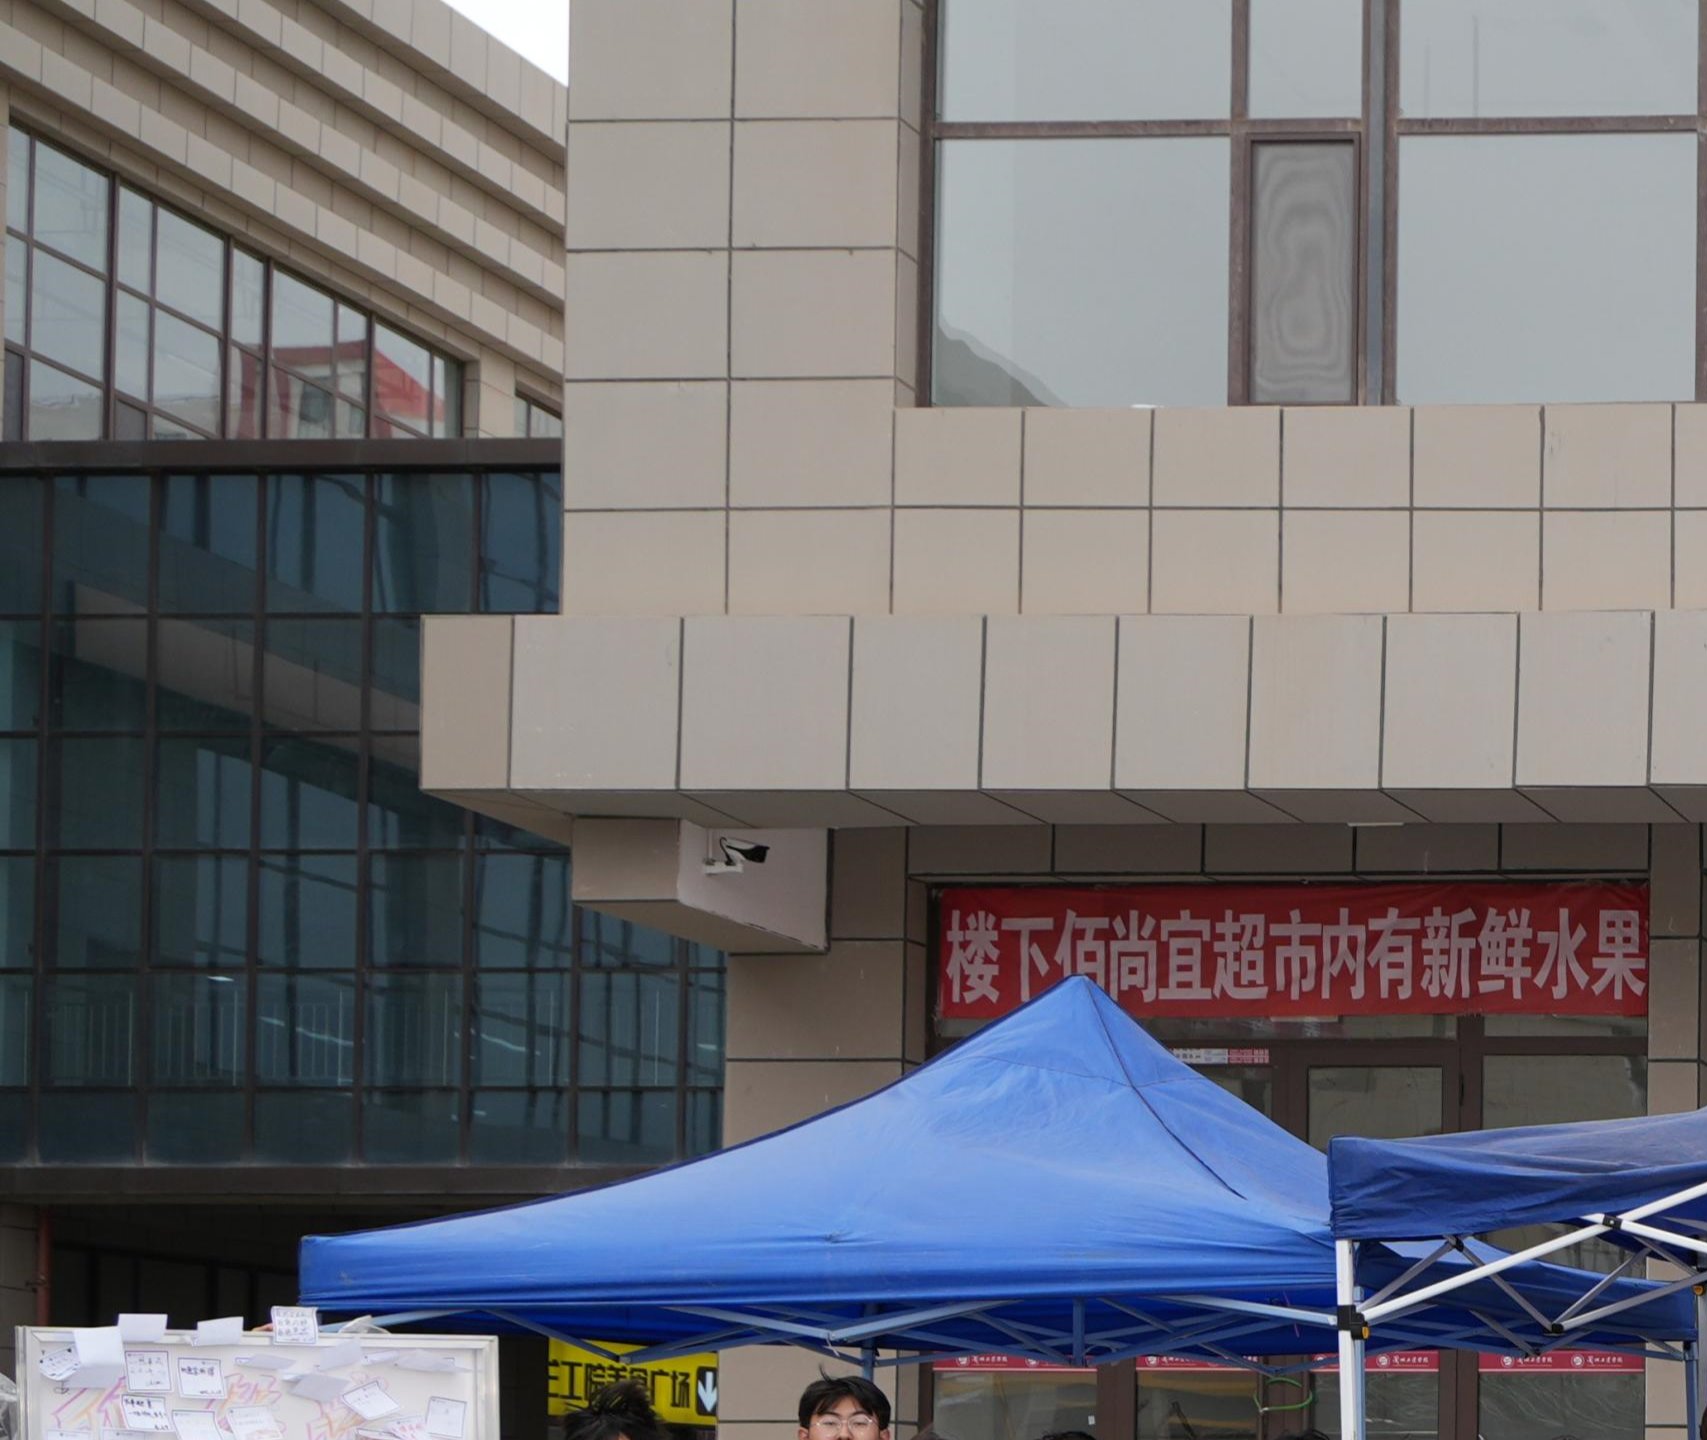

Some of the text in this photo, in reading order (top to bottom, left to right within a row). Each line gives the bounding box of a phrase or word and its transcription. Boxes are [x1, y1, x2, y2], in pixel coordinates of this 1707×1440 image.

[947, 907, 1646, 1004] 楼下佰尚宜超市内有新鲜水果
